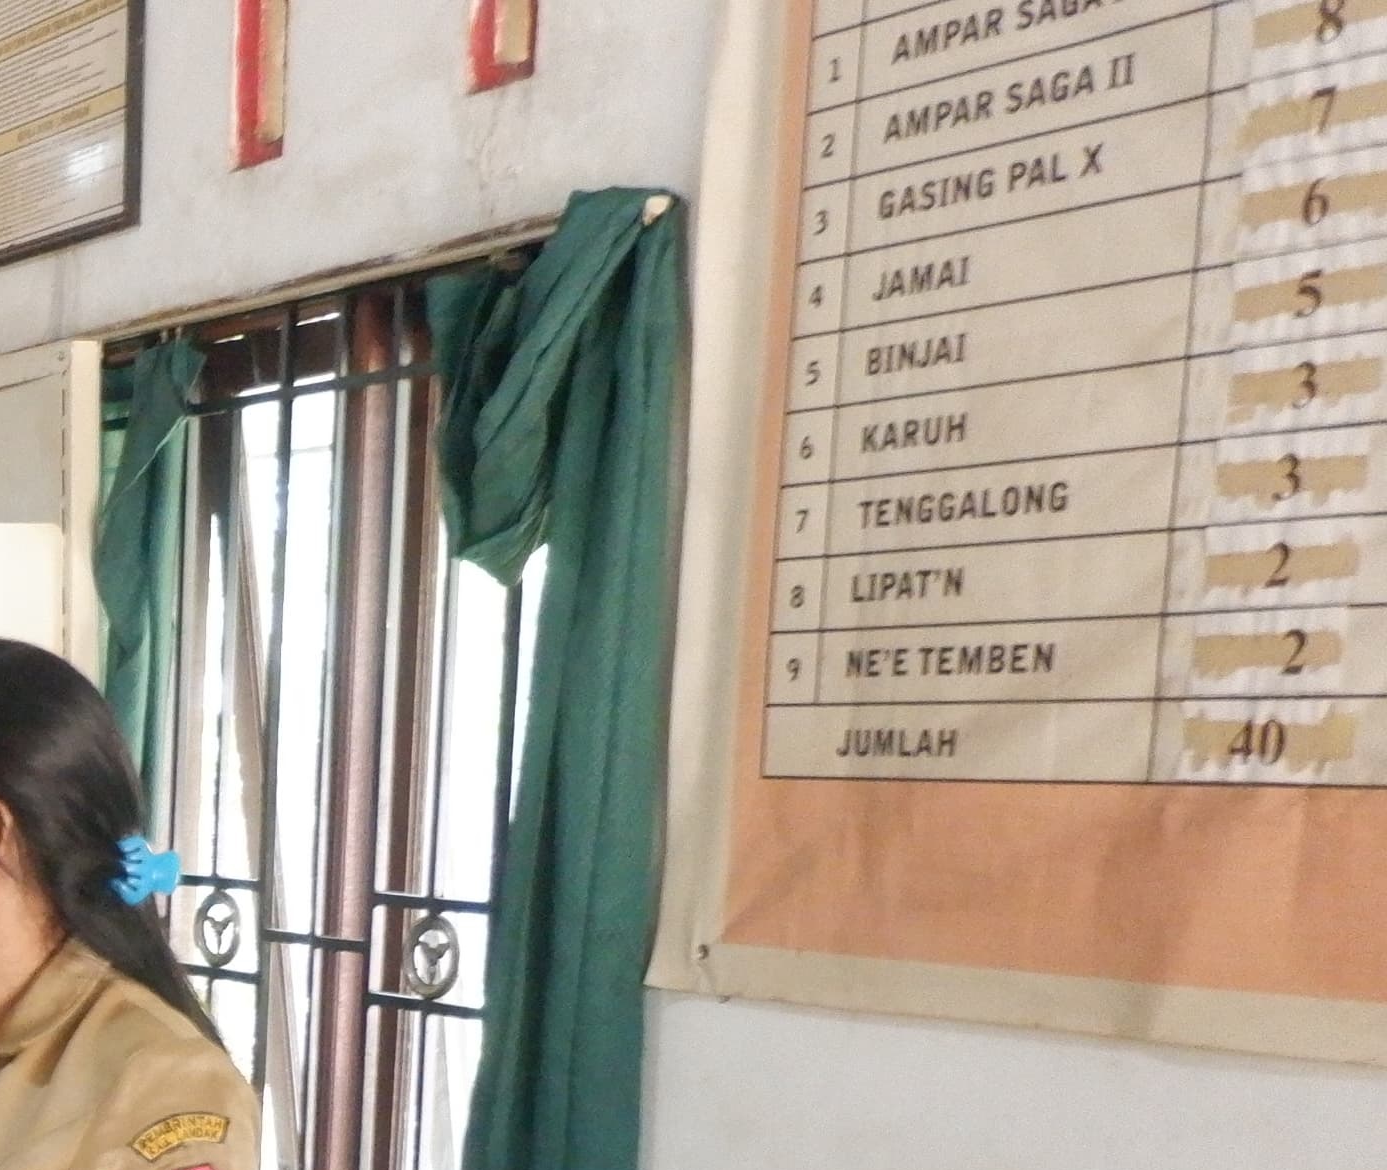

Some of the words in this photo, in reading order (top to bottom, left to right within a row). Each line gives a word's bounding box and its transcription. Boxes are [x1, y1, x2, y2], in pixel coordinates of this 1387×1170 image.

[820, 133, 836, 158] 2
[884, 91, 994, 143] AMPAR
[1005, 65, 1095, 114] SAGA
[1105, 53, 1135, 90] II
[1316, 0, 1345, 44] 8
[828, 57, 841, 83] 1
[891, 8, 1003, 65] AMPAR
[813, 210, 828, 235] 3
[878, 168, 995, 220] GASING
[1007, 153, 1066, 192] PAL
[1080, 142, 1104, 177] X
[1311, 85, 1336, 134] 7
[809, 285, 822, 308] 4
[873, 256, 970, 301] JAMAI
[1302, 177, 1330, 227] 6
[805, 360, 821, 386] 5
[866, 333, 967, 376] BINJAI
[1292, 269, 1323, 319] 5
[800, 436, 814, 459] 6
[862, 412, 968, 453] KARUH
[1291, 361, 1317, 409] 3
[796, 509, 809, 533] 7
[859, 481, 1069, 529] TENGGALONG
[1272, 453, 1301, 501] 3
[790, 584, 804, 608] 8
[850, 568, 963, 602] LIPAT'N
[1265, 541, 1292, 588] 2
[786, 657, 801, 681] 9
[919, 643, 1055, 675] TEMBEN
[1281, 628, 1308, 675] 2
[836, 728, 957, 757] JUMLAH
[1228, 718, 1286, 765] 40
